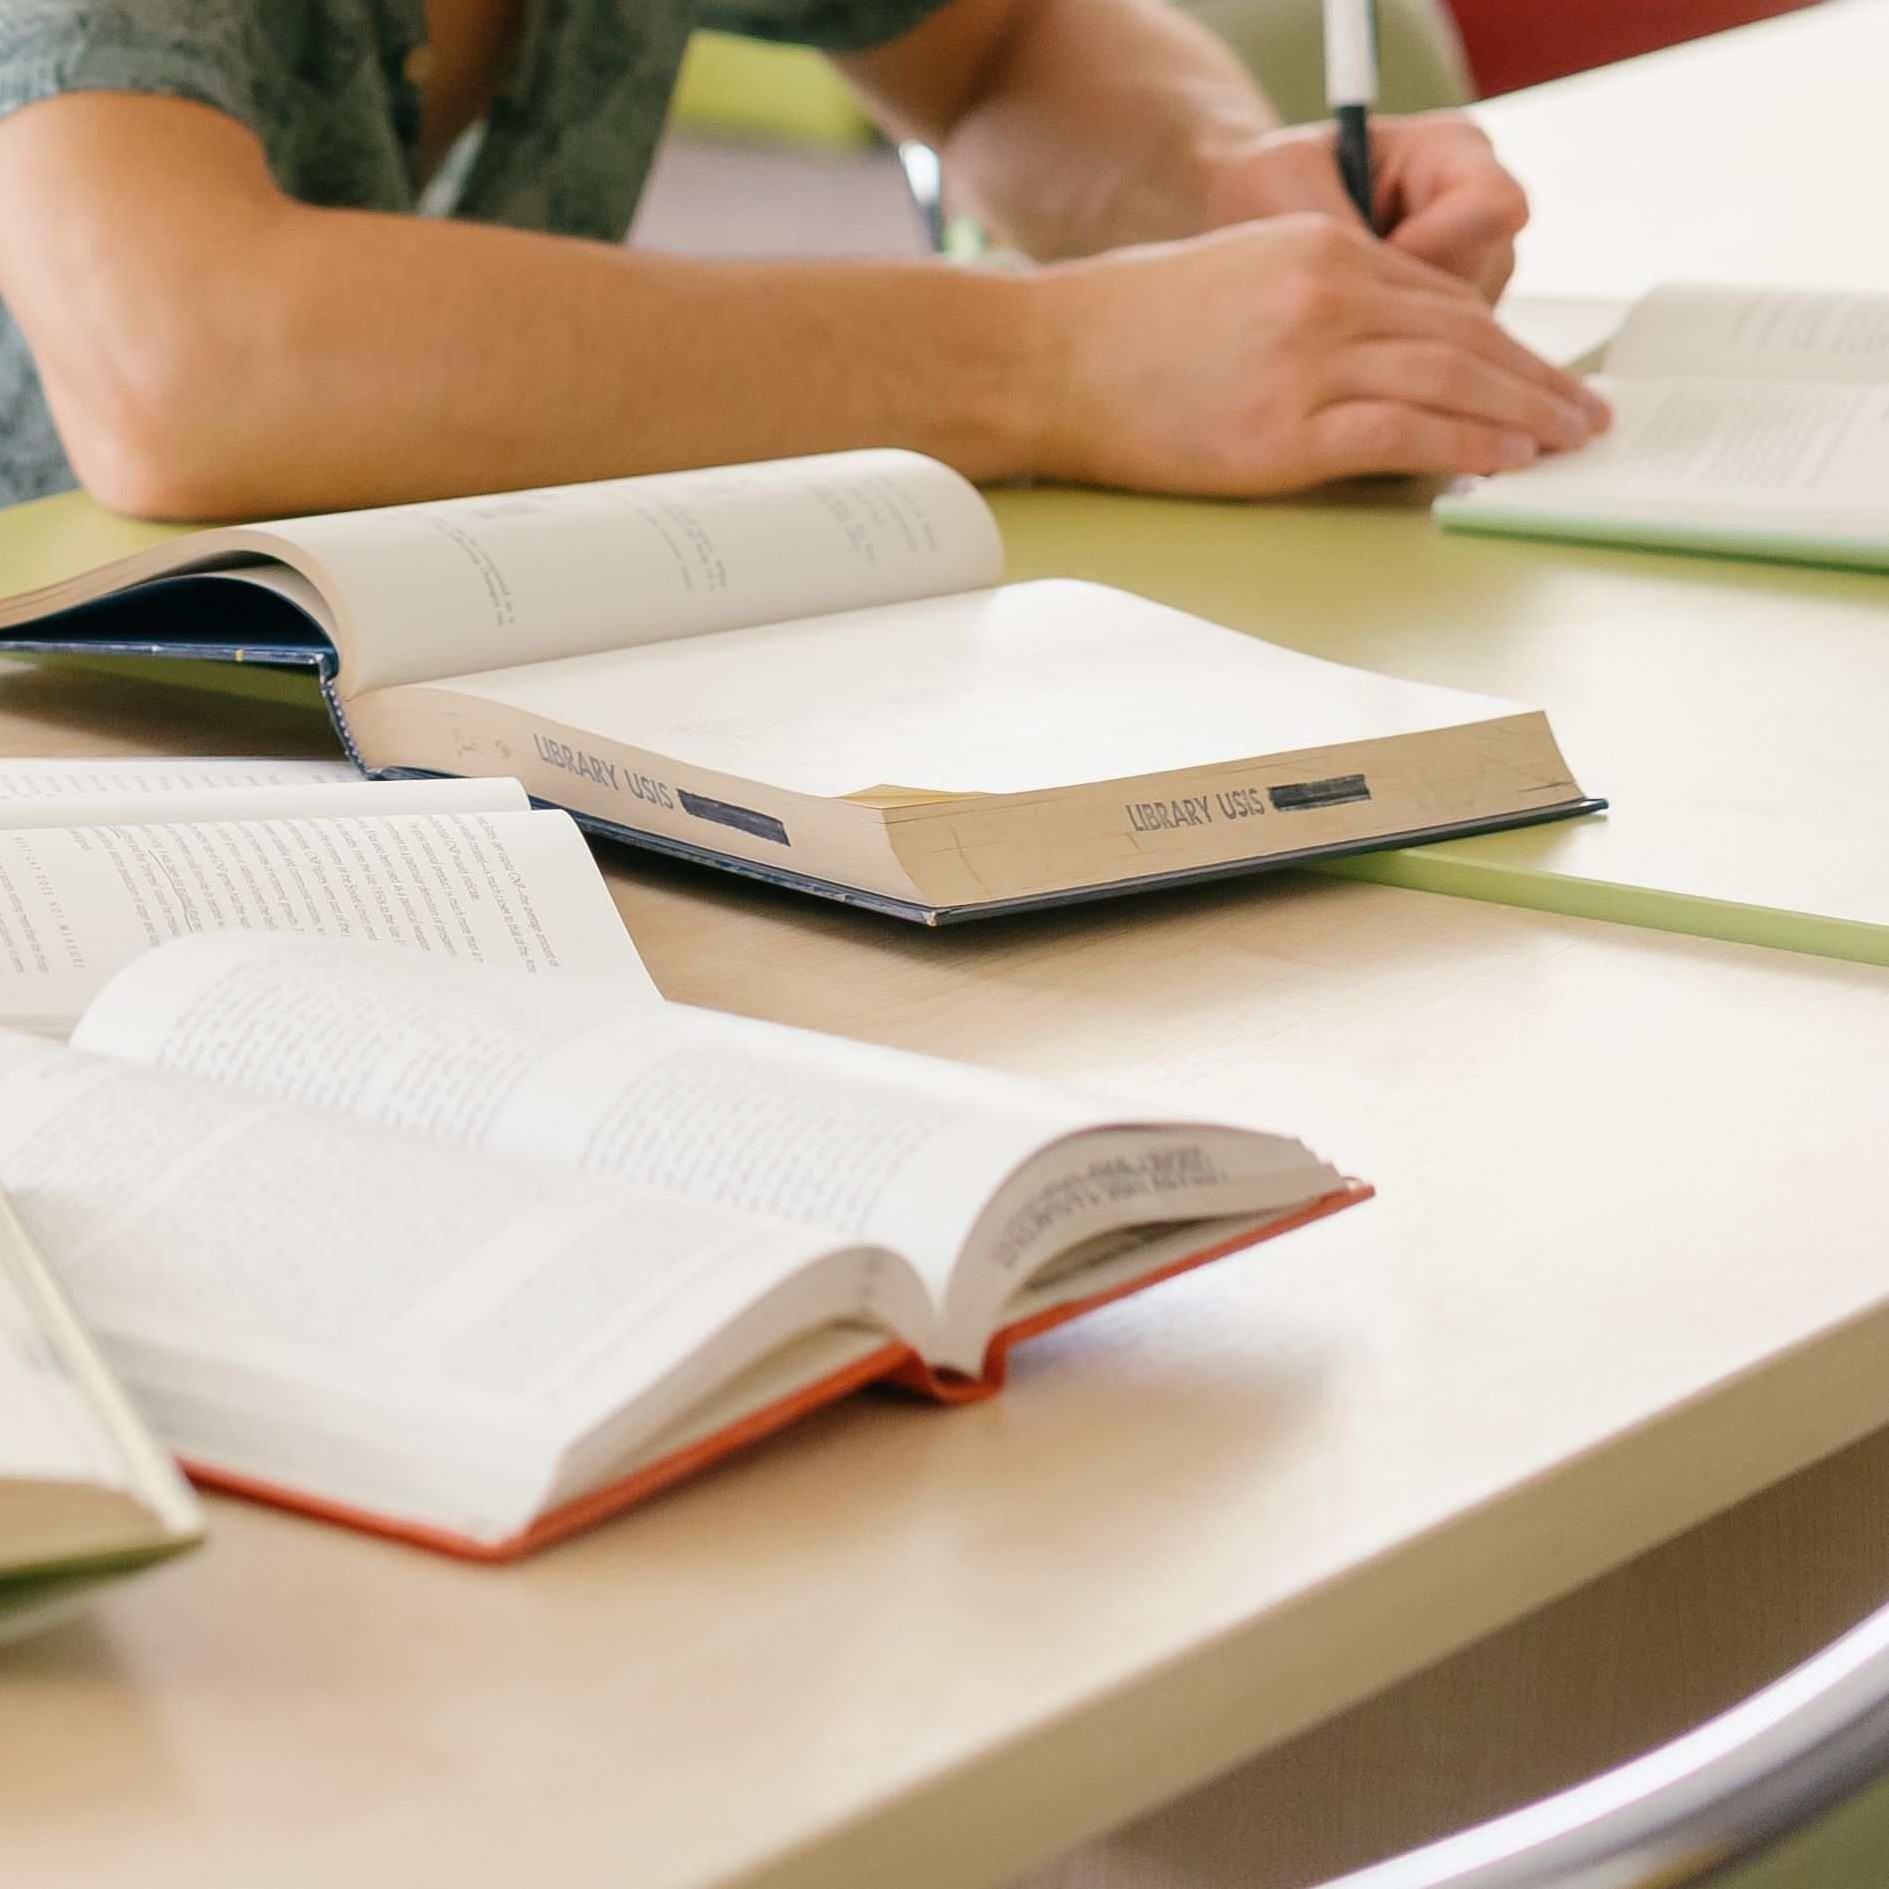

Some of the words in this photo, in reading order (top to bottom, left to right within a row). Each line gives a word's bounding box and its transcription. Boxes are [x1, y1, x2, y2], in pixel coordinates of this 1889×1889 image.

[533, 733, 619, 792] LIBRARY
[623, 768, 675, 811] USIS
[1126, 796, 1212, 833] LIBRARY
[1217, 787, 1266, 821] USIS
[419, 842, 443, 864] national
[450, 855, 471, 874] would
[384, 869, 402, 883] used
[427, 865, 454, 890] product
[483, 875, 502, 893] much
[445, 897, 466, 915] much
[492, 895, 512, 914] closer
[505, 924, 522, 936] that
